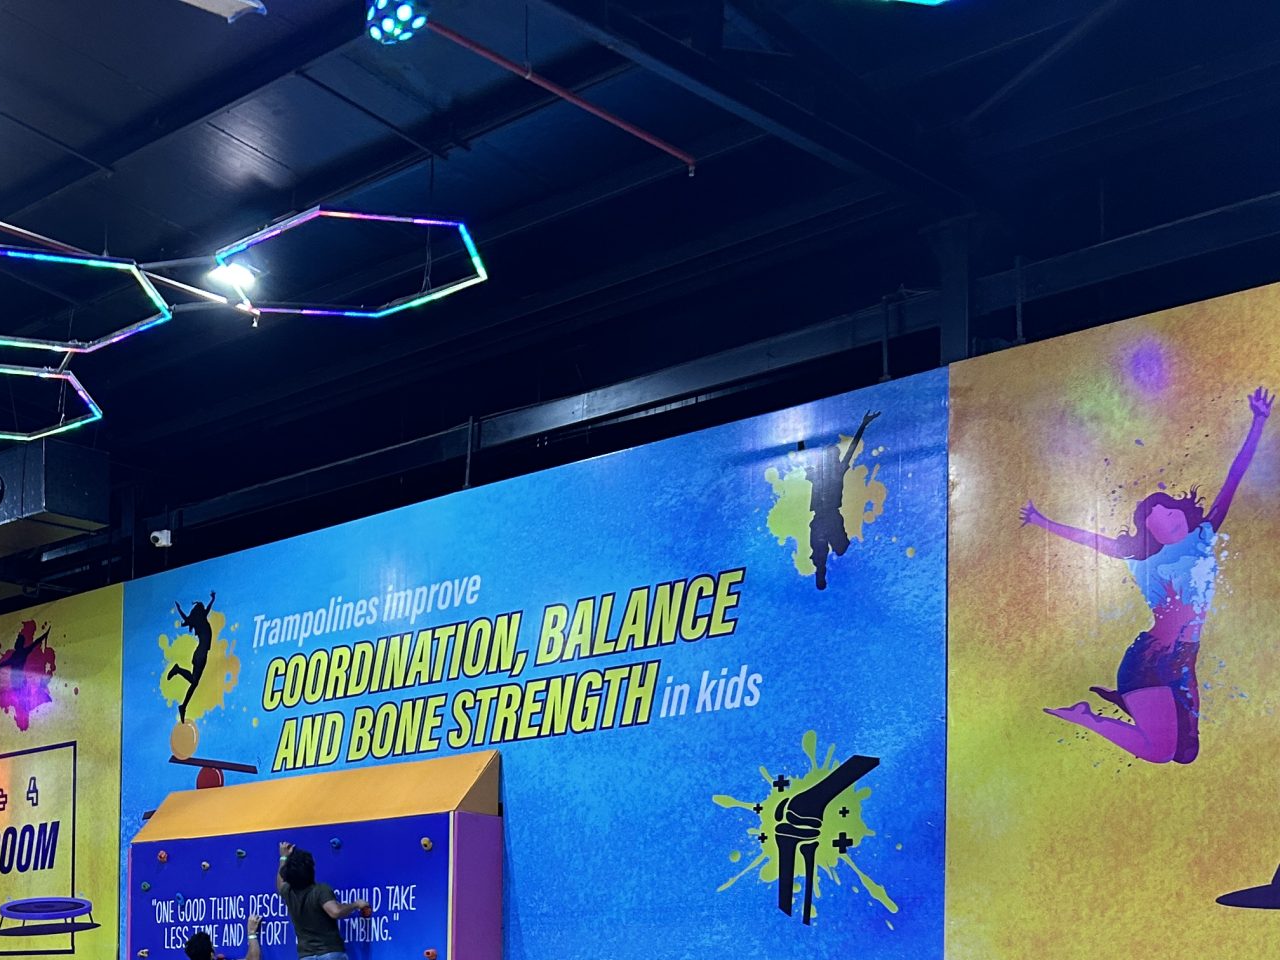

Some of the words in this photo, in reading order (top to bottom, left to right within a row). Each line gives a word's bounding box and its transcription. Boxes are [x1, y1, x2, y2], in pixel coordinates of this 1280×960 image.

[253, 596, 379, 648] Trampolines
[382, 574, 481, 625] improve
[262, 609, 528, 711] COORDINATION,
[534, 567, 746, 667] BALANCE
[271, 710, 345, 773] AND
[346, 693, 448, 763] BONE
[447, 659, 661, 749] STRENGTH
[660, 676, 690, 718] in
[695, 665, 763, 714] kids
[164, 926, 189, 949] LESS
[222, 923, 244, 947] AND
[178, 898, 206, 922] GOOD
[209, 895, 246, 920] THING,
[386, 885, 417, 911] TAKE
